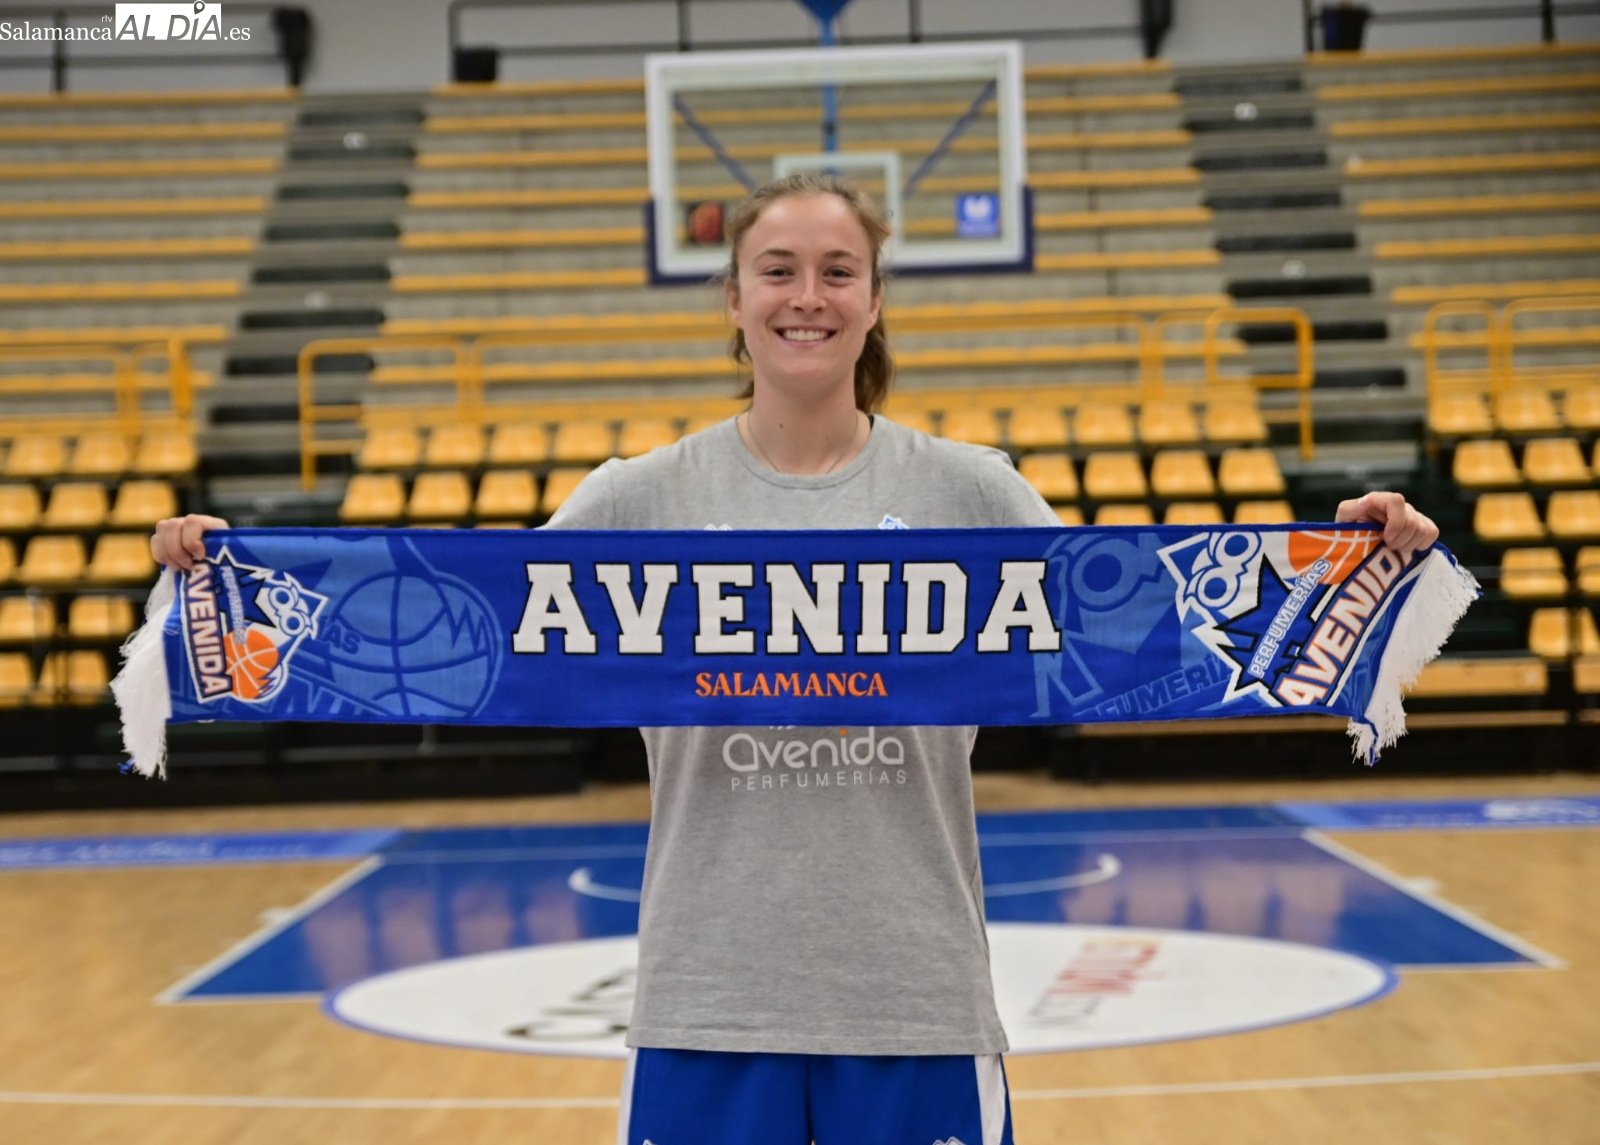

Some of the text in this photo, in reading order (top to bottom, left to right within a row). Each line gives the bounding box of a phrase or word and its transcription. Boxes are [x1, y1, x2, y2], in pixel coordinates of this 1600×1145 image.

[188, 563, 232, 694] AVENIDA
[511, 560, 1063, 655] AVENIDA
[1247, 559, 1332, 678] PERFUMERÍAS
[694, 671, 889, 698] SALAMANCA
[722, 726, 905, 772] avenida
[731, 767, 907, 792] PERFUMERÍAS
